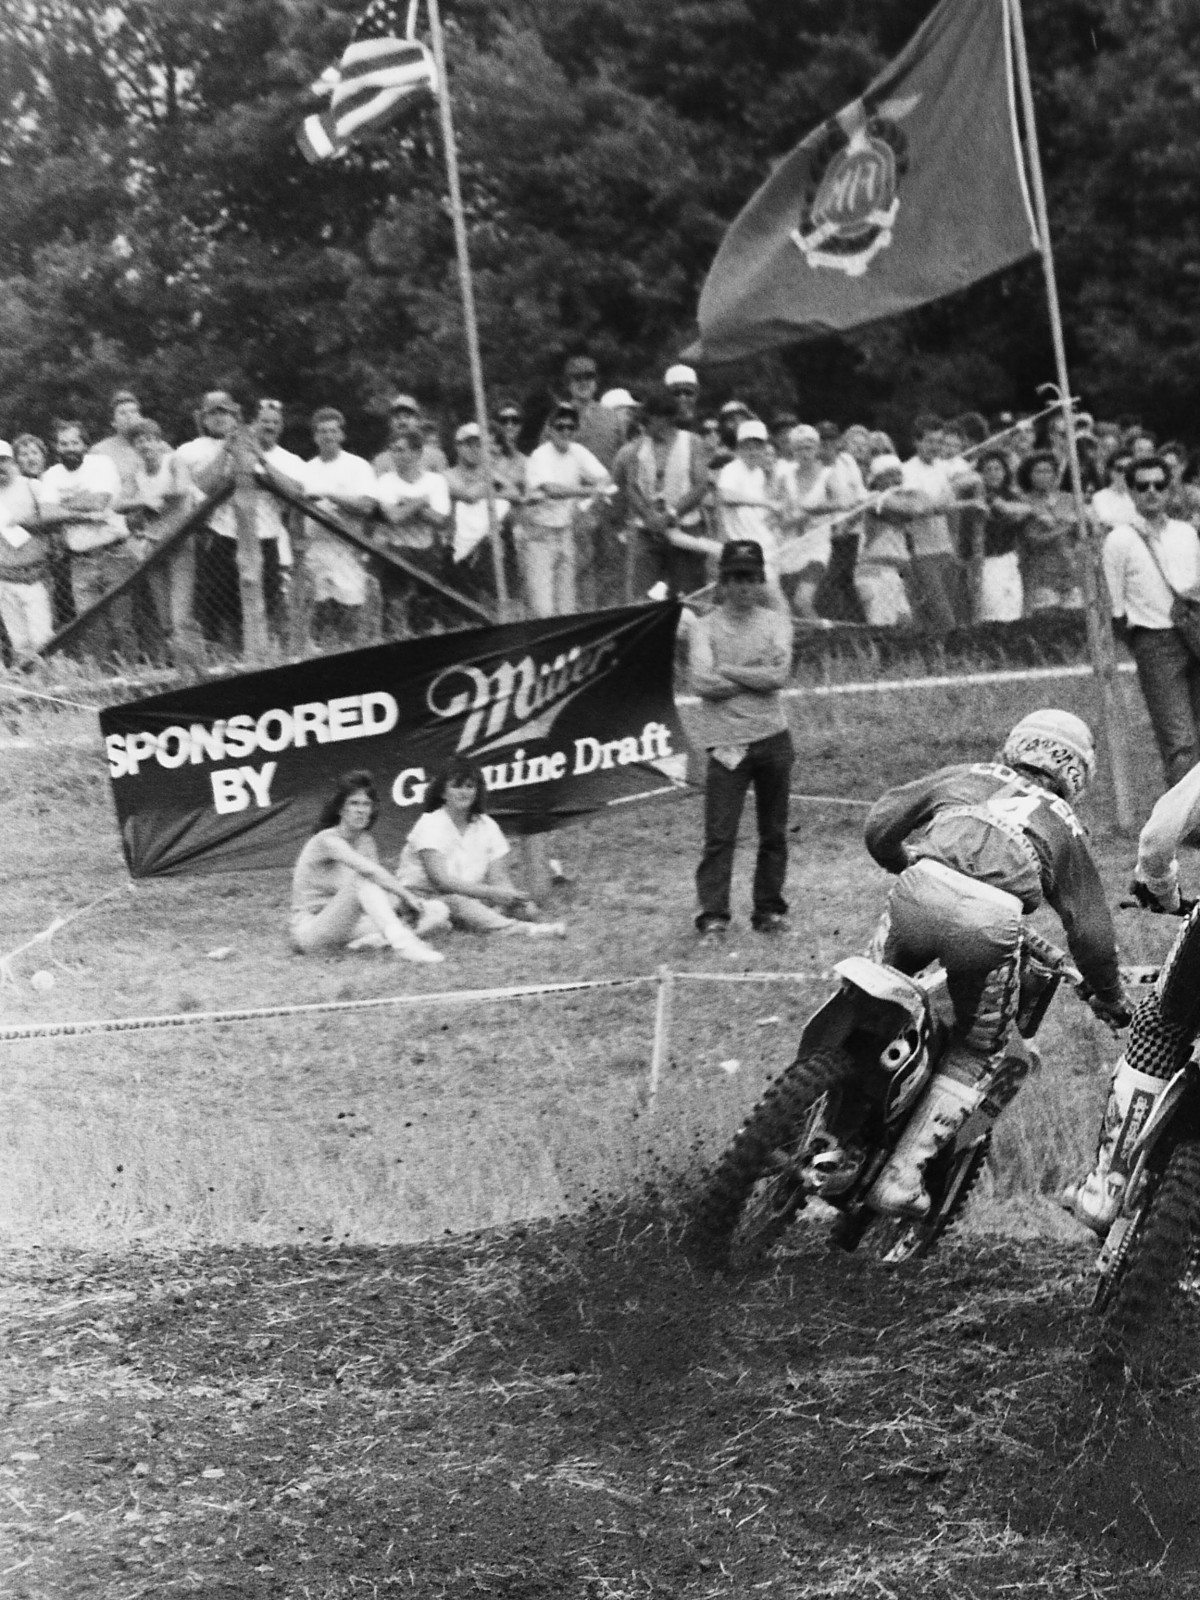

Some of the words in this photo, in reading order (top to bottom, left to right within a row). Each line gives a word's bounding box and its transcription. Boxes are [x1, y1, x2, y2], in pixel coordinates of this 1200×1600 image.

[105, 691, 399, 779] SPONSORED
[391, 748, 567, 807] Guine
[572, 721, 673, 776] Draft
[211, 761, 278, 815] BY
